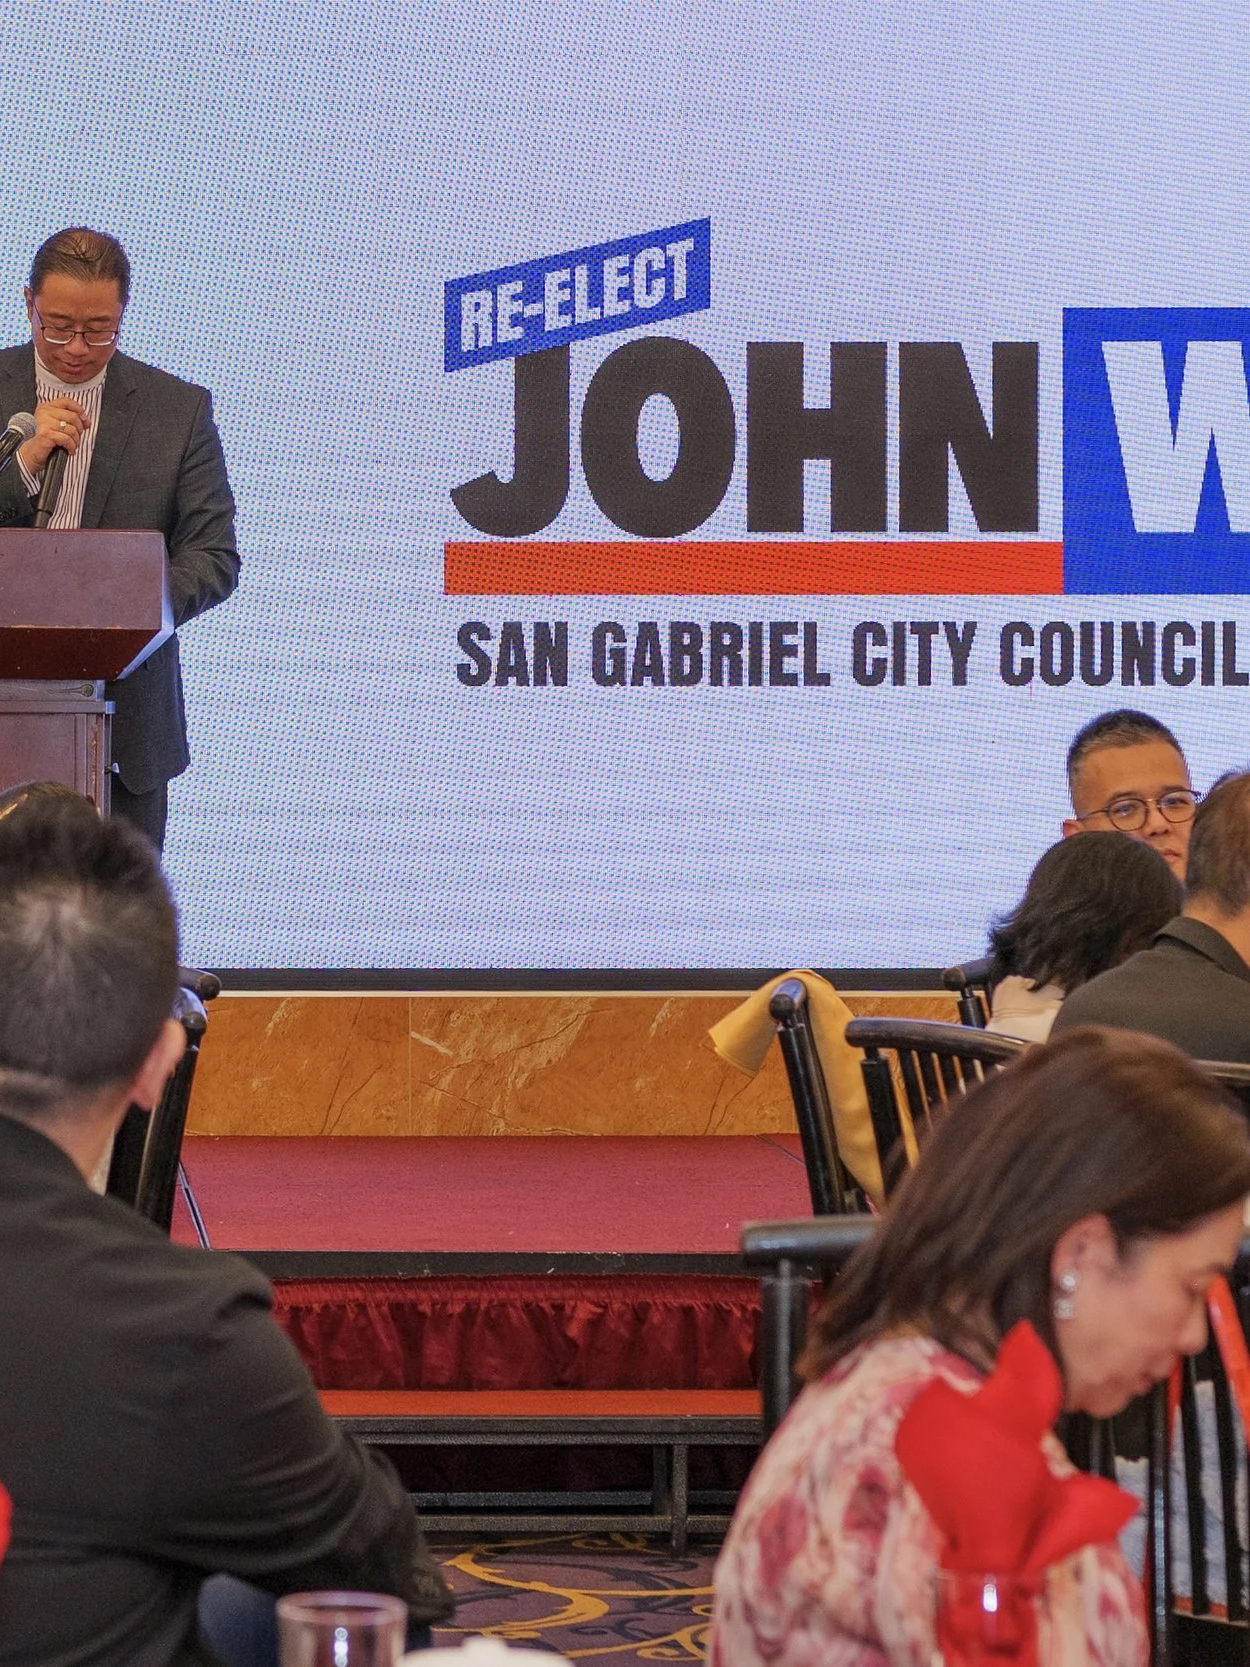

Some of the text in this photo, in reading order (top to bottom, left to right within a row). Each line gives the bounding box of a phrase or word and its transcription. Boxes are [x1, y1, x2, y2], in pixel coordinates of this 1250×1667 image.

[460, 238, 694, 351] RE-ELECT
[450, 336, 1039, 538] JOHN
[456, 621, 568, 687] SAN
[591, 621, 830, 687] GABRIEL
[852, 621, 977, 687] CITY
